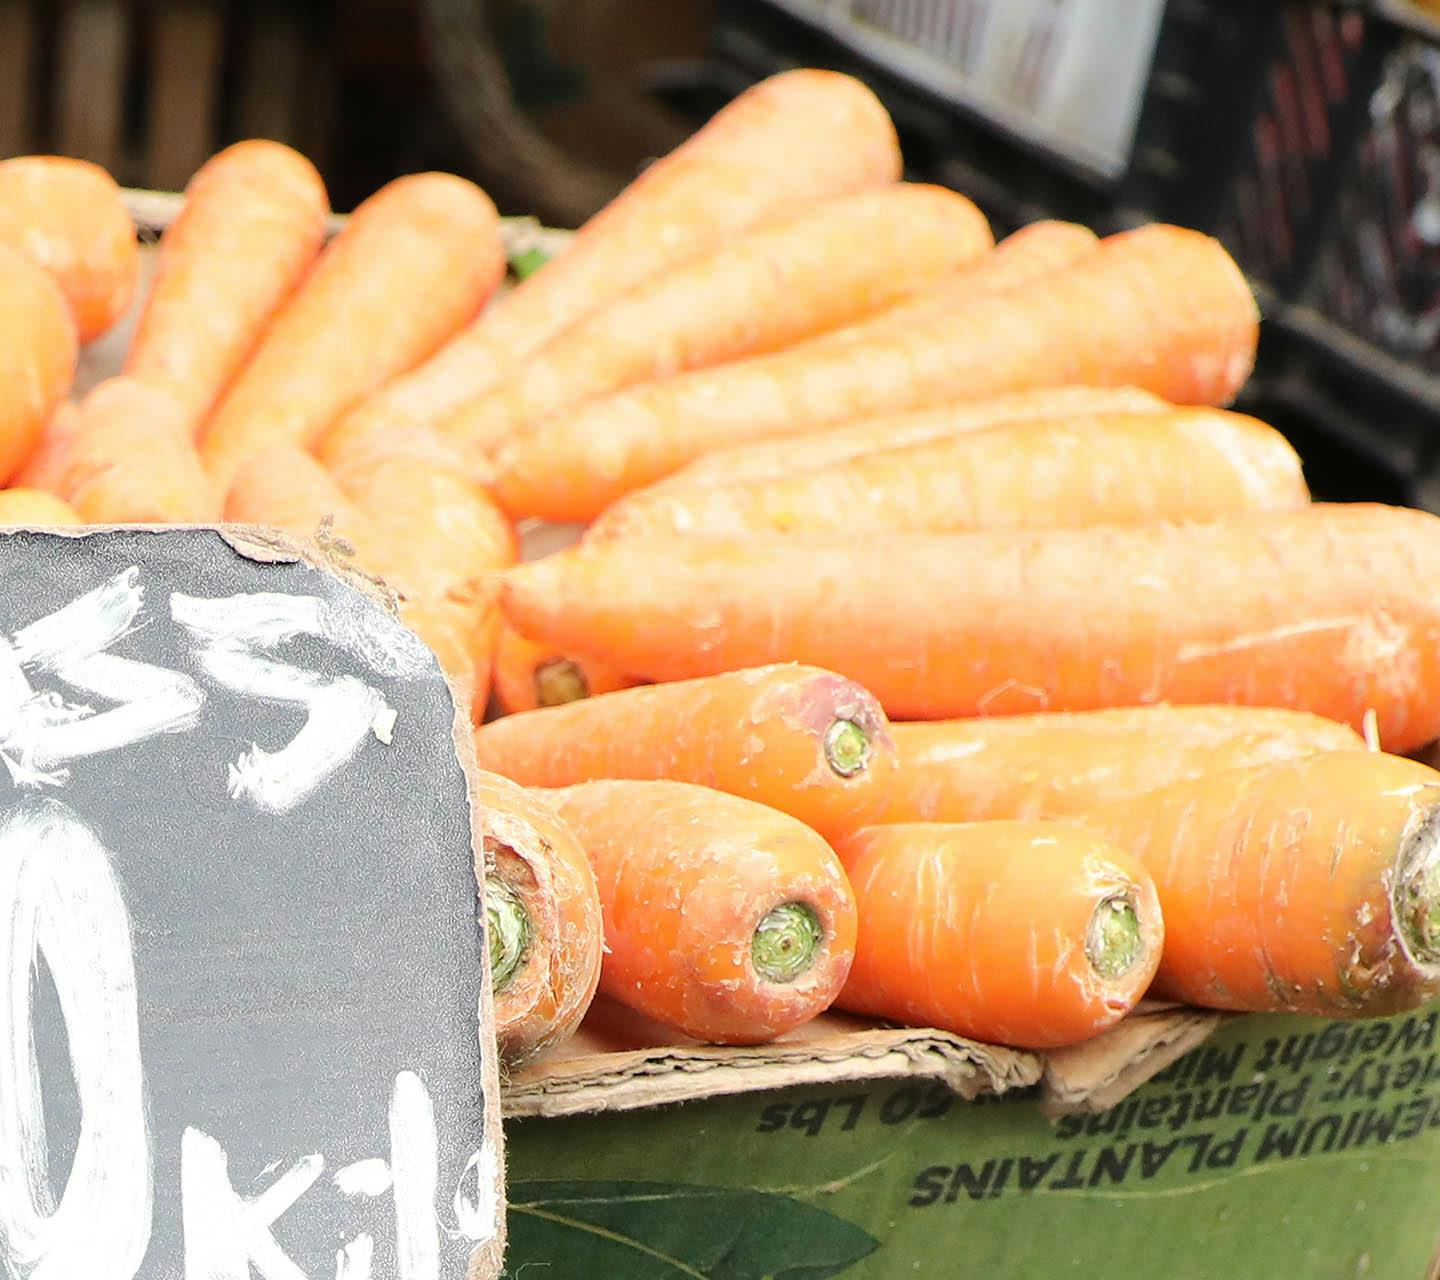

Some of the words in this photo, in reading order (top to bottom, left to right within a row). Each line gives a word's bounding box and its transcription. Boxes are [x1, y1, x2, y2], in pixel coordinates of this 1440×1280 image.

[1260, 1008, 1440, 1079] Weight
[755, 1095, 869, 1136] Lbs
[1055, 1076, 1313, 1141] Plantains
